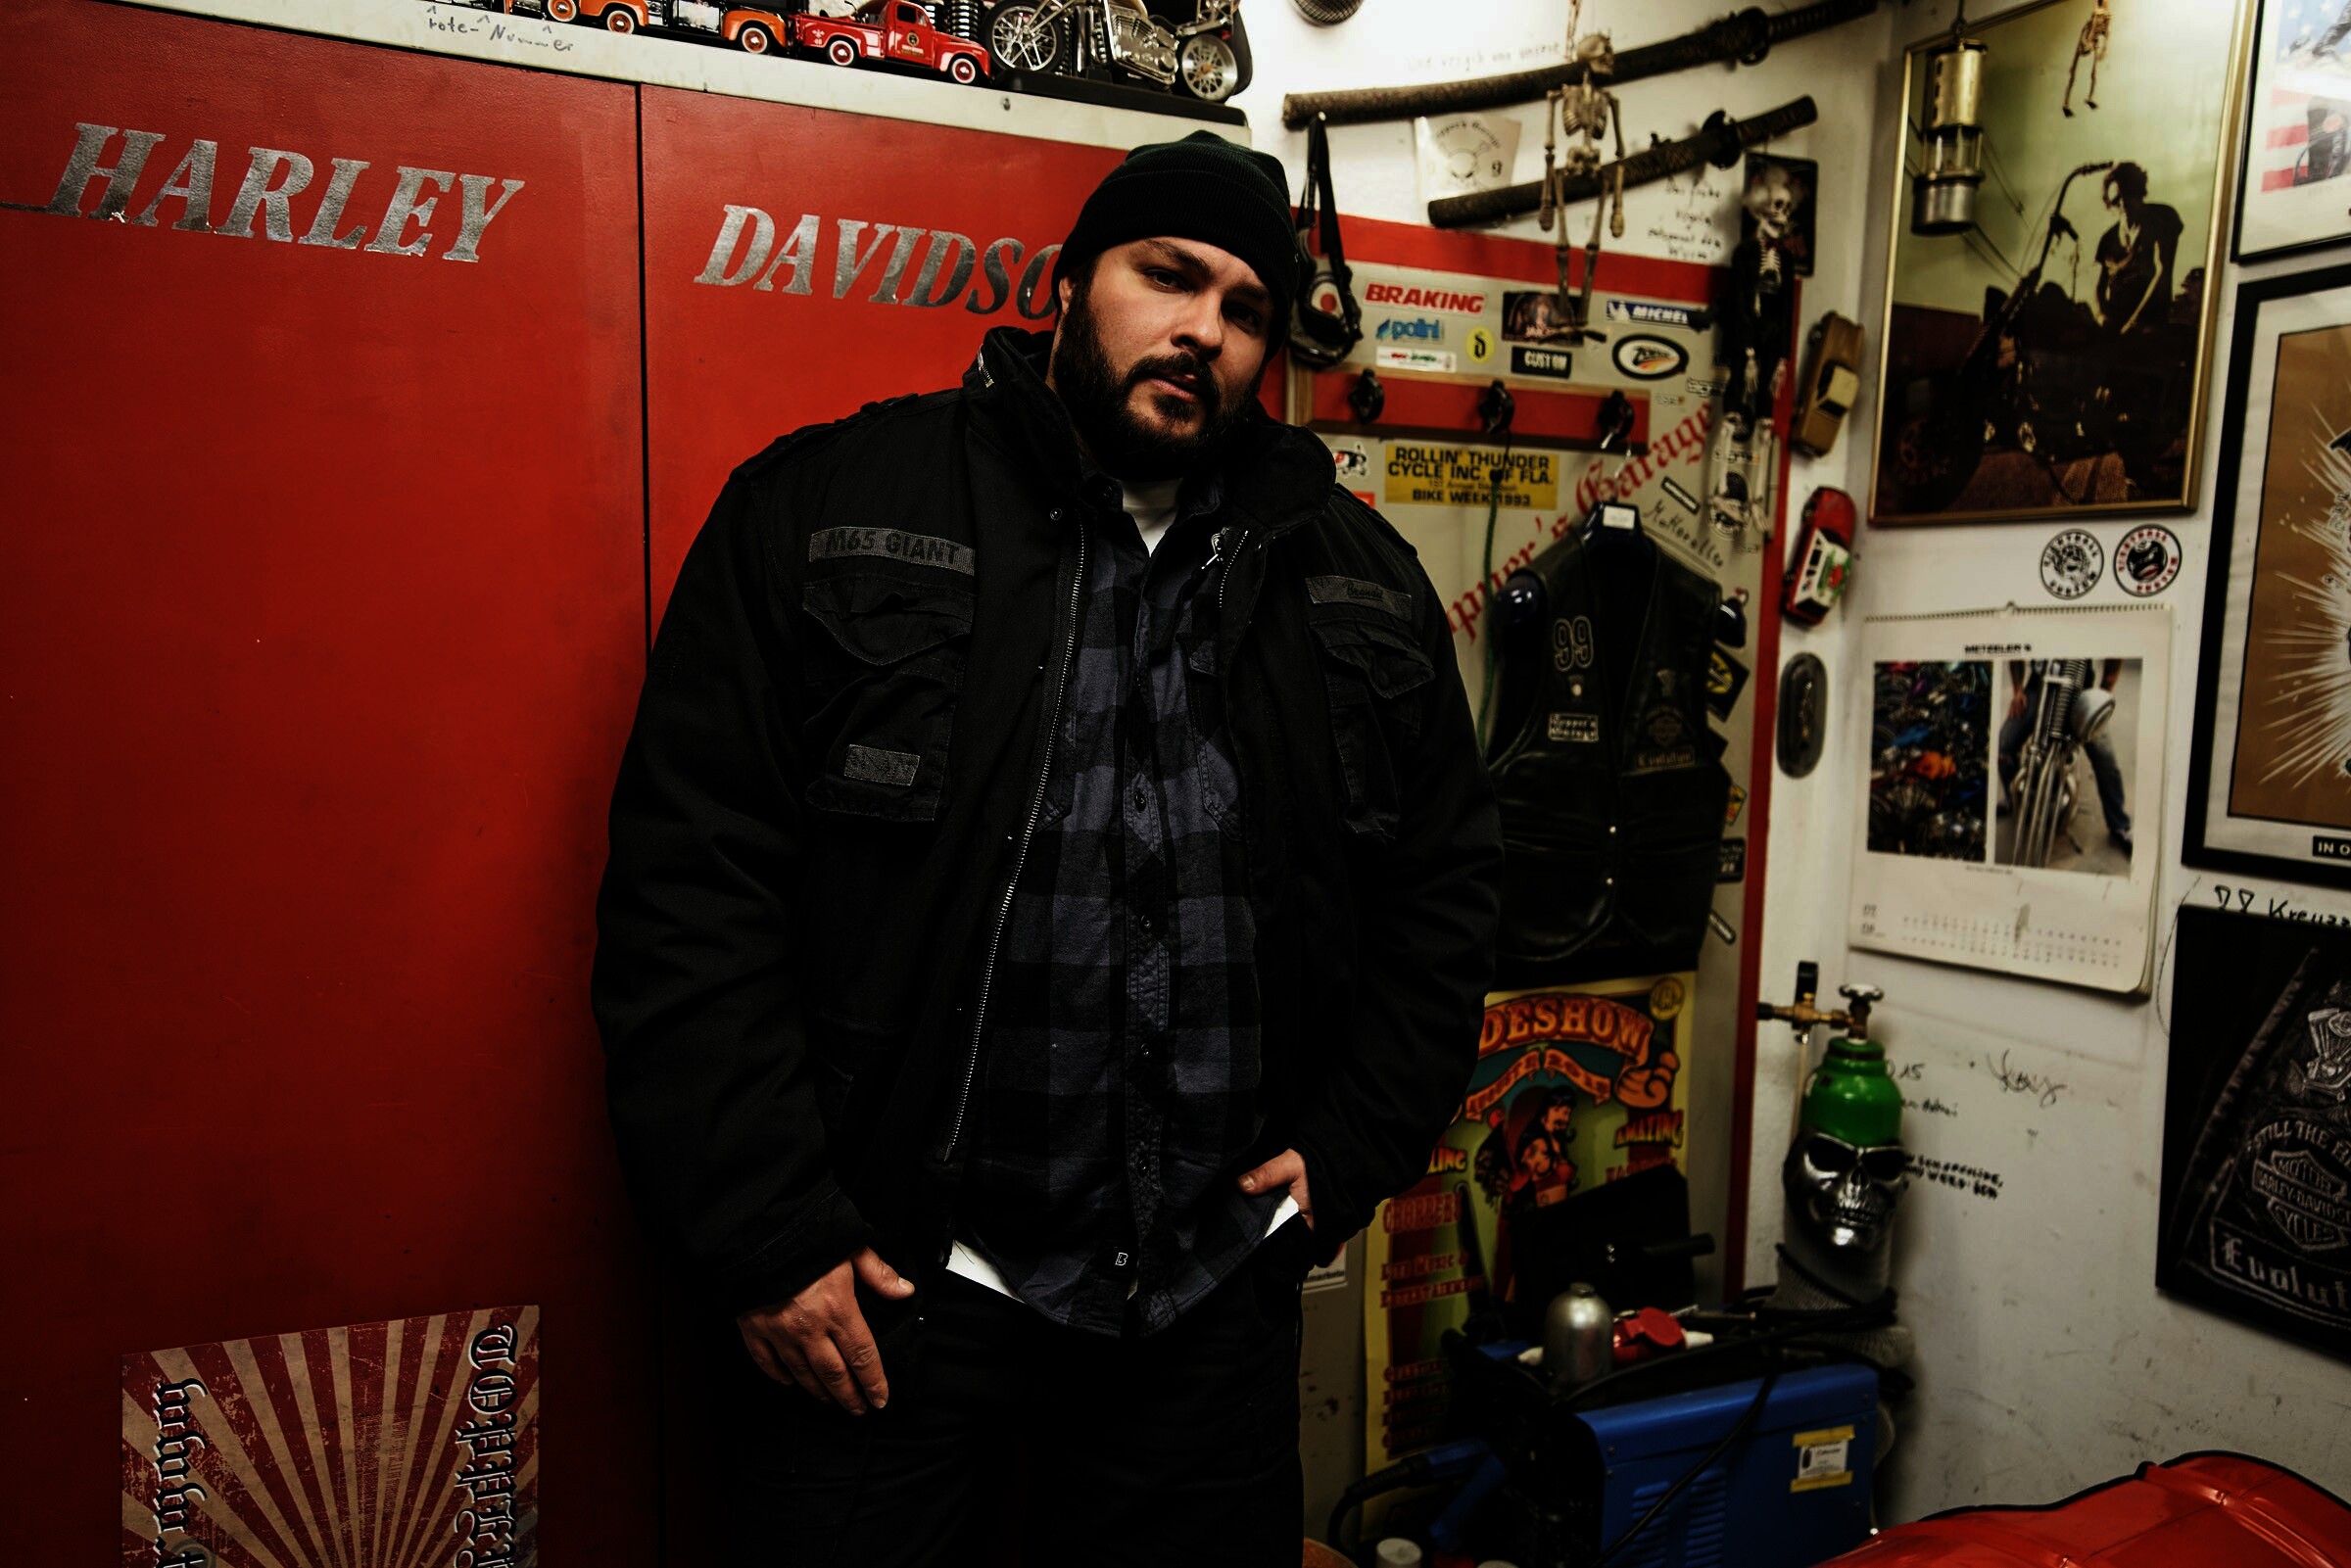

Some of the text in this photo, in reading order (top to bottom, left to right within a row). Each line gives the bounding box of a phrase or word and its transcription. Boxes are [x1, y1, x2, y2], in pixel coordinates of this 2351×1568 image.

[43, 121, 526, 263] HARLEY
[693, 203, 1064, 320] DAVIDSO
[1366, 283, 1484, 313] BRAKING
[1632, 305, 1689, 324] MICHEL
[1392, 317, 1440, 340] polini
[1388, 461, 1554, 485] CYCLE INC. F FLA.
[1395, 447, 1550, 469] ROLLIN' THUNDER
[1413, 490, 1530, 506] BIKE WEEK 1993
[825, 530, 959, 565] M65 GIANT
[1553, 614, 1596, 672] 99
[2318, 841, 2351, 856] IN O
[1479, 994, 1654, 1058] DESHOW
[1614, 1109, 1684, 1149] AMAZING
[2253, 1119, 2292, 1156] STILL
[2295, 1120, 2329, 1151] THE
[1426, 1147, 1467, 1173] LING
[2221, 1231, 2351, 1313] Evolut
[153, 1377, 209, 1568] www.t
